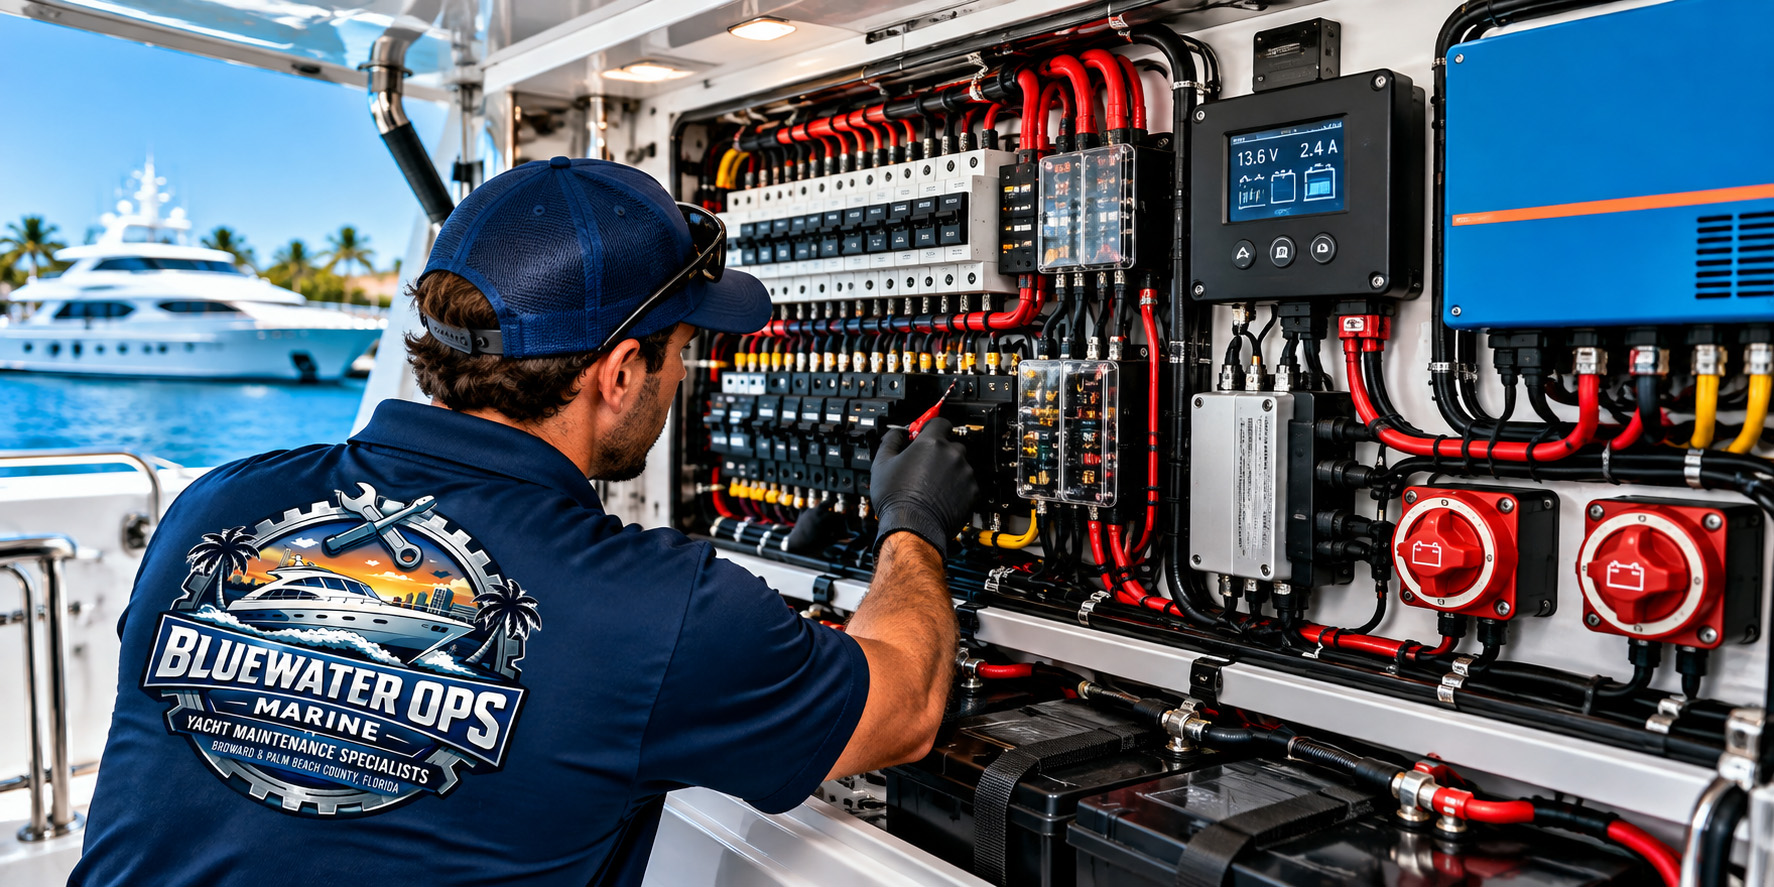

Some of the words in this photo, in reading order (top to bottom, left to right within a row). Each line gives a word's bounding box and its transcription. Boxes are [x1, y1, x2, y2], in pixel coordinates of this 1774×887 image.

[1237, 148, 1266, 167] 13.6
[1269, 147, 1279, 162] V
[1300, 140, 1324, 158] 2.4
[1327, 138, 1338, 155] A
[155, 625, 403, 715] BLUEWATER
[407, 680, 507, 750] OPS
[253, 697, 381, 742] MARINE
[187, 715, 231, 736] YACHT
[233, 724, 337, 760] MAINTENANCE
[339, 748, 429, 784] SPECIALISTS
[211, 740, 255, 758] BROWARD
[256, 749, 264, 759] &
[266, 751, 291, 766] PALM
[292, 757, 321, 773] BEACH
[322, 763, 360, 785] COUNTY,
[362, 774, 399, 794] FLORIDA
